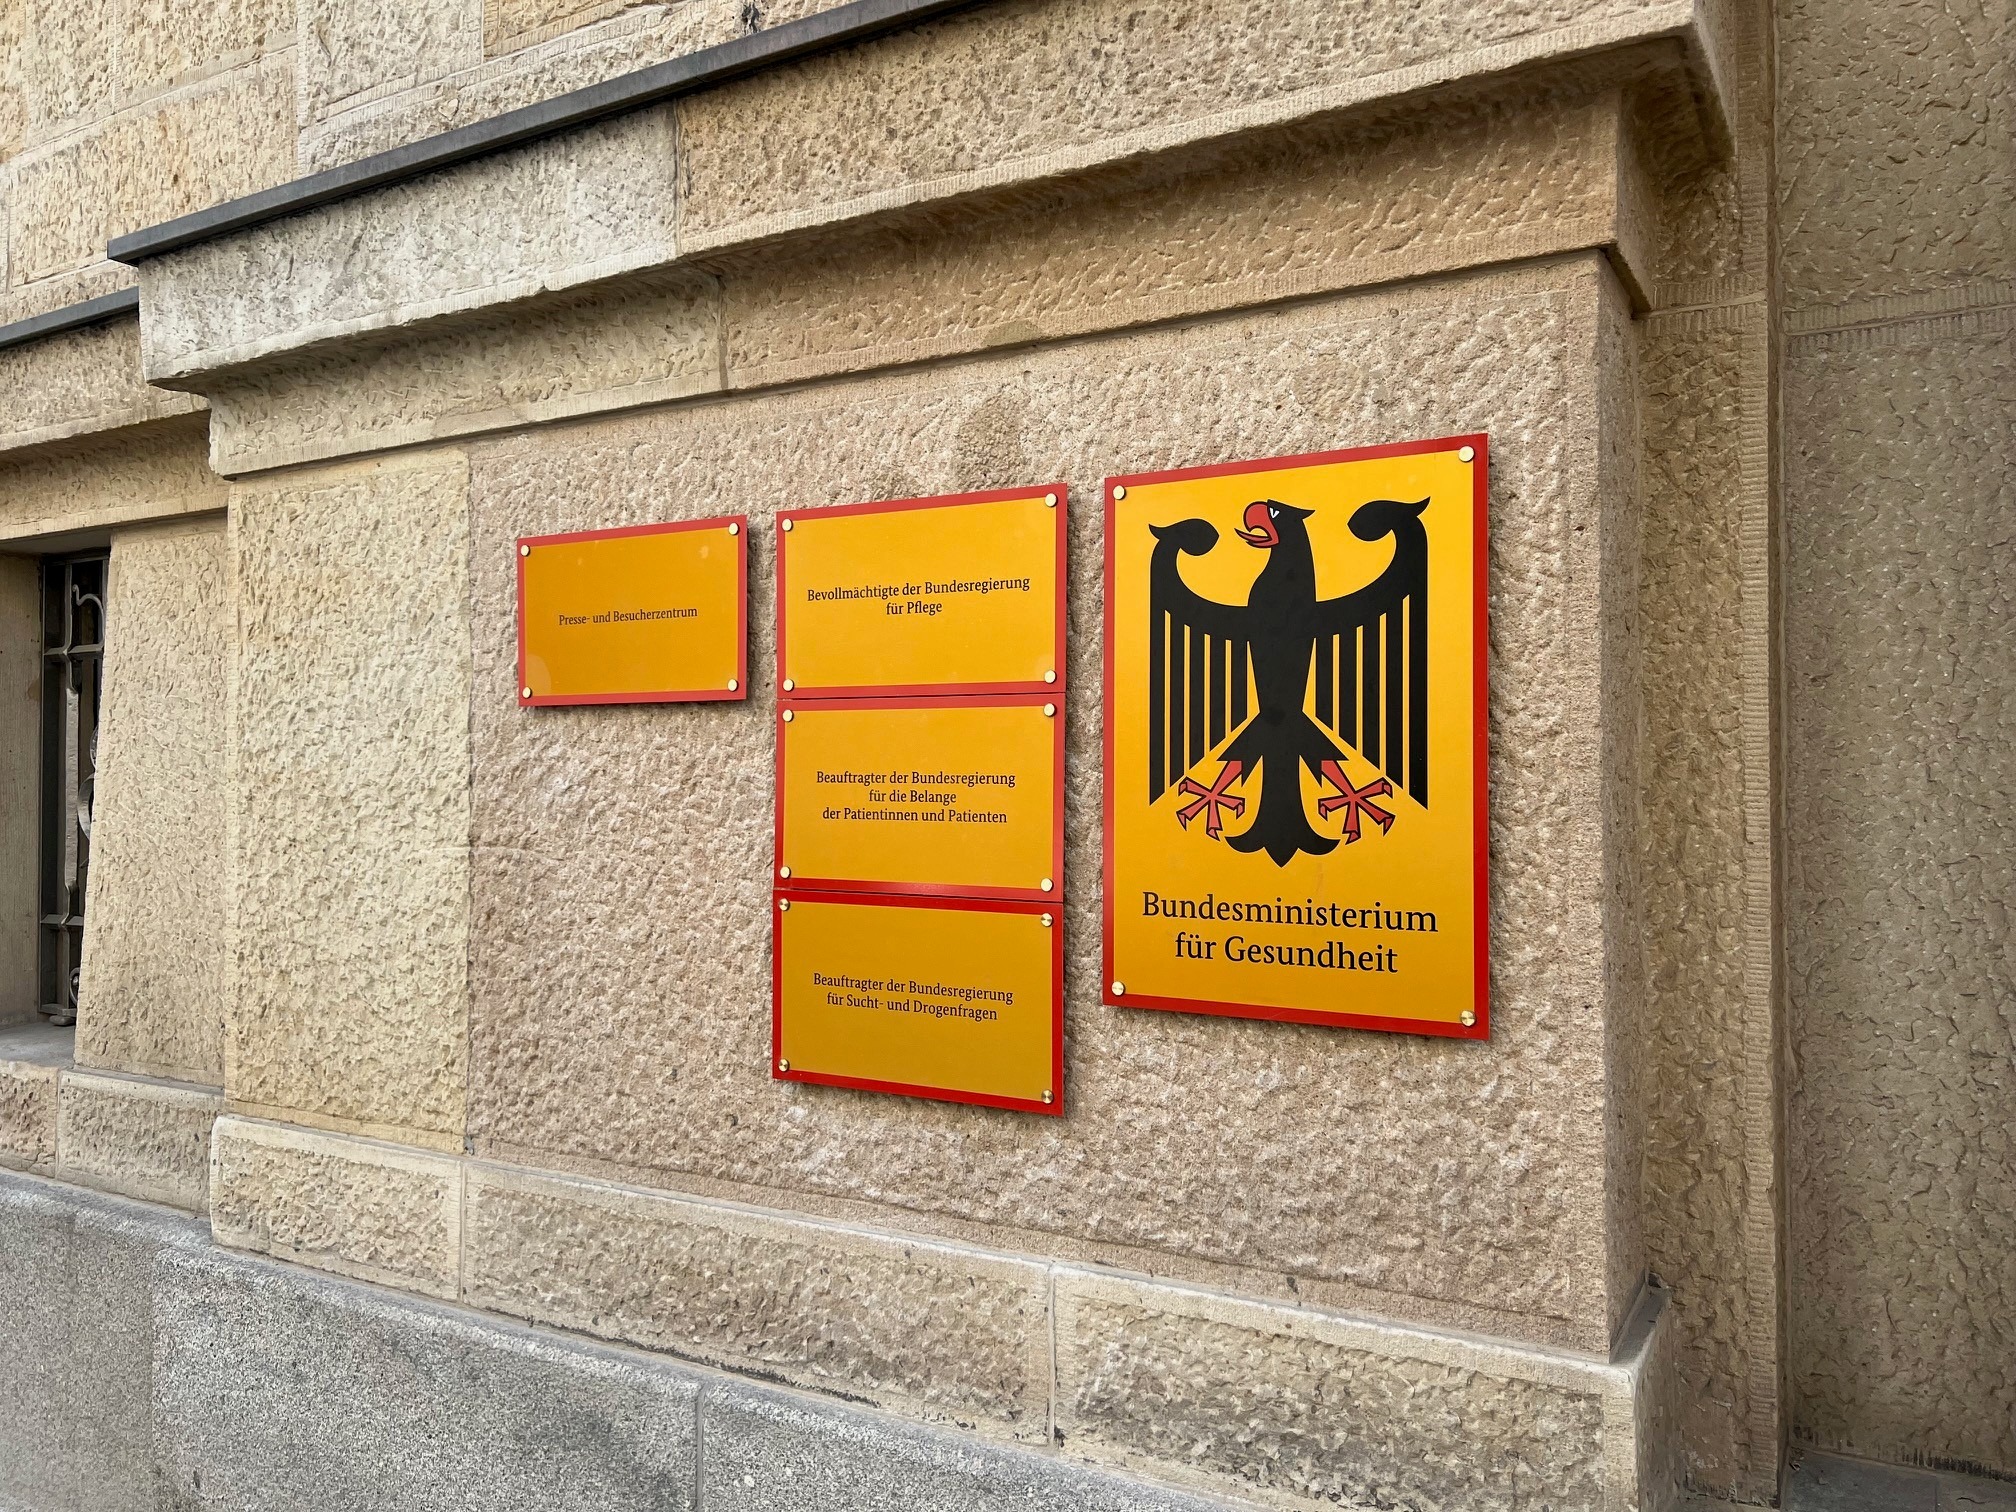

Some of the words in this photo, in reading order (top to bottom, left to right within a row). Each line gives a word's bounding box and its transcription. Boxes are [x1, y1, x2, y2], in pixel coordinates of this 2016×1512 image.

[807, 585, 899, 601] Bevollmächtigte
[902, 583, 921, 596] der
[925, 577, 1031, 595] Bundesregierung
[559, 615, 590, 625] Presse-
[593, 611, 611, 623] und
[613, 608, 698, 622] Besucherzentrum
[886, 602, 904, 615] für
[907, 601, 942, 616] Pflege
[816, 771, 886, 786] Beauftragter
[889, 772, 908, 784] der
[911, 772, 1016, 788] Bundesregierung
[869, 790, 886, 802] für
[889, 790, 907, 802] die
[910, 790, 957, 806] Belange
[823, 807, 841, 820] der
[844, 808, 918, 821] Patientinnen
[922, 809, 945, 822] und
[948, 809, 1007, 823] Patienten
[1142, 891, 1439, 932] Bundesministerium
[1175, 932, 1216, 960] für
[1224, 935, 1399, 973] Gesundheit
[813, 973, 884, 992] Beauftragter
[886, 979, 906, 993] der
[909, 981, 1013, 1005] Bundesregierung
[827, 992, 844, 1005] für
[846, 994, 883, 1009] Sucht-
[887, 999, 910, 1011] und
[913, 1000, 997, 1021] Drogenfragen
